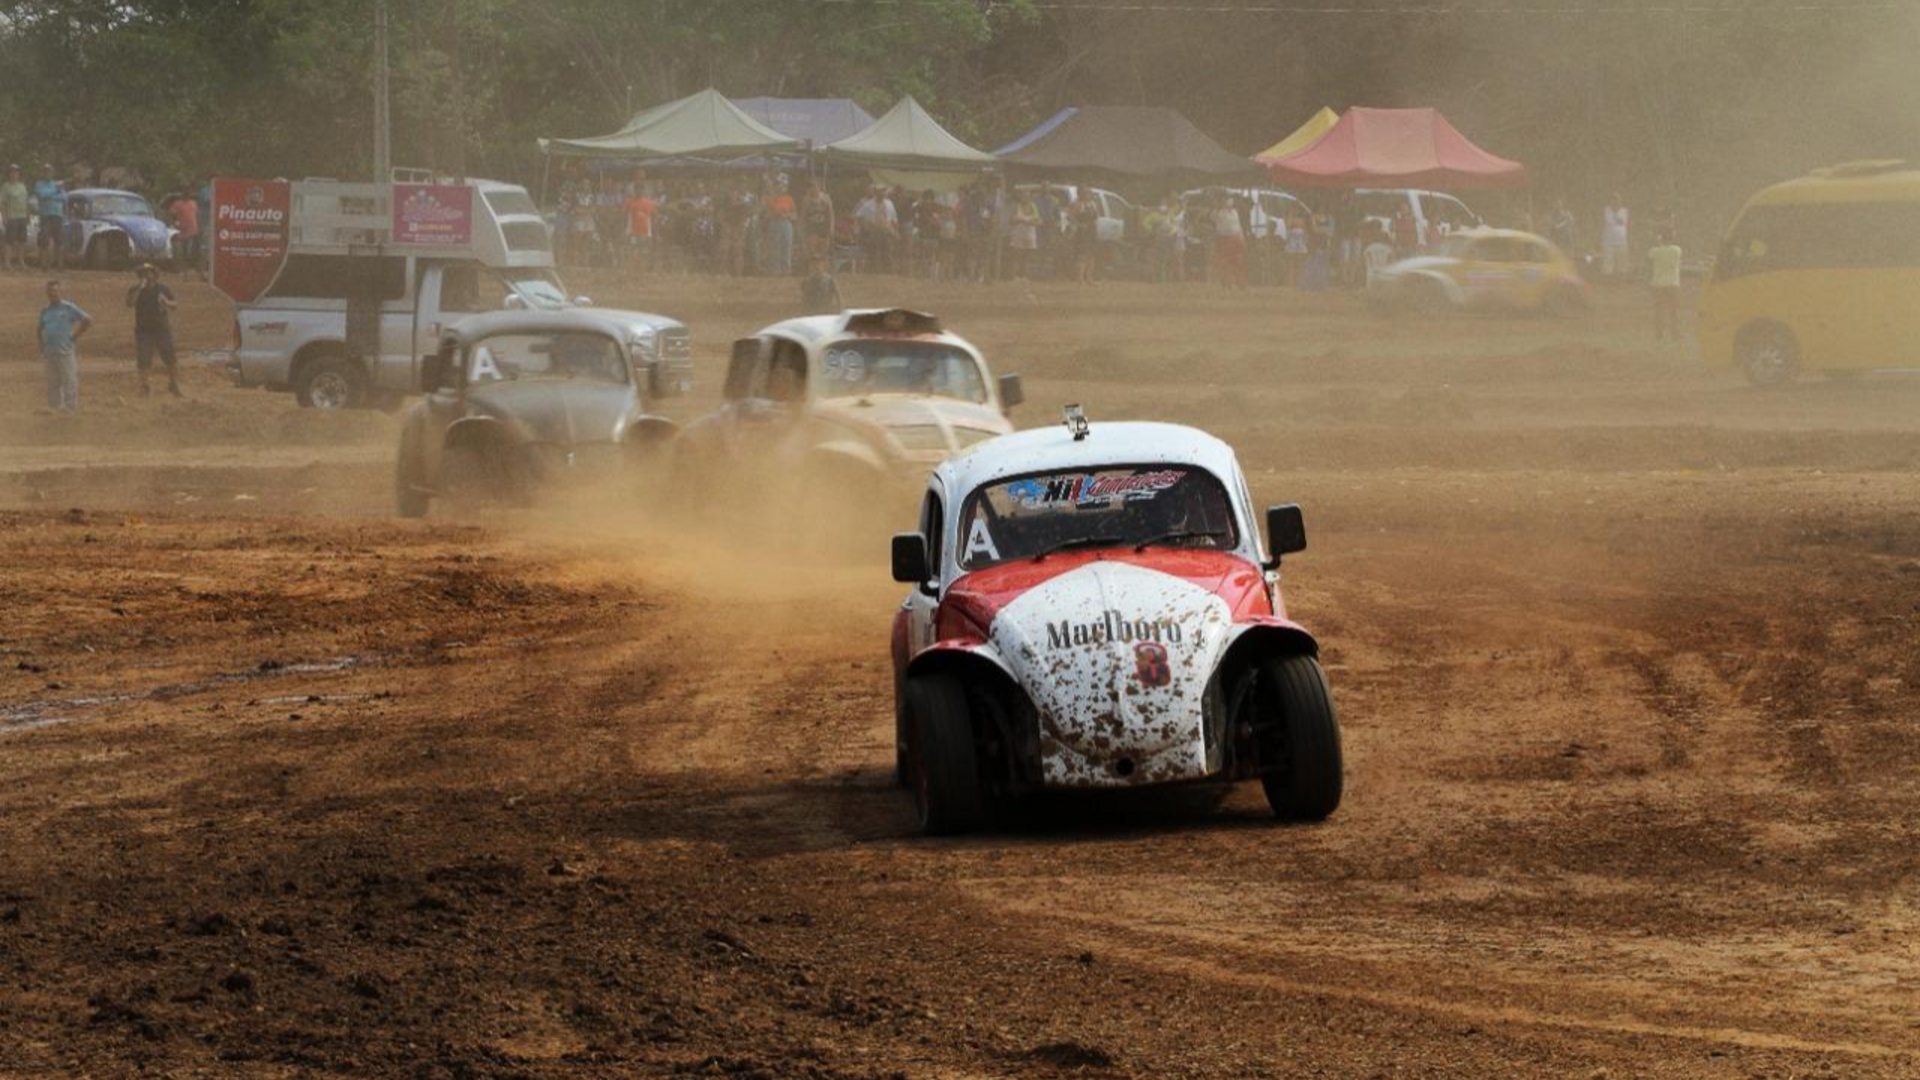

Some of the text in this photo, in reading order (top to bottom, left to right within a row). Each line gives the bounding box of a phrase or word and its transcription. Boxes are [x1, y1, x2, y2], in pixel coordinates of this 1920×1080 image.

[219, 204, 283, 221] Pinauto
[471, 346, 503, 380] A
[964, 518, 1000, 560] A
[1046, 609, 1182, 649] Marlboro
